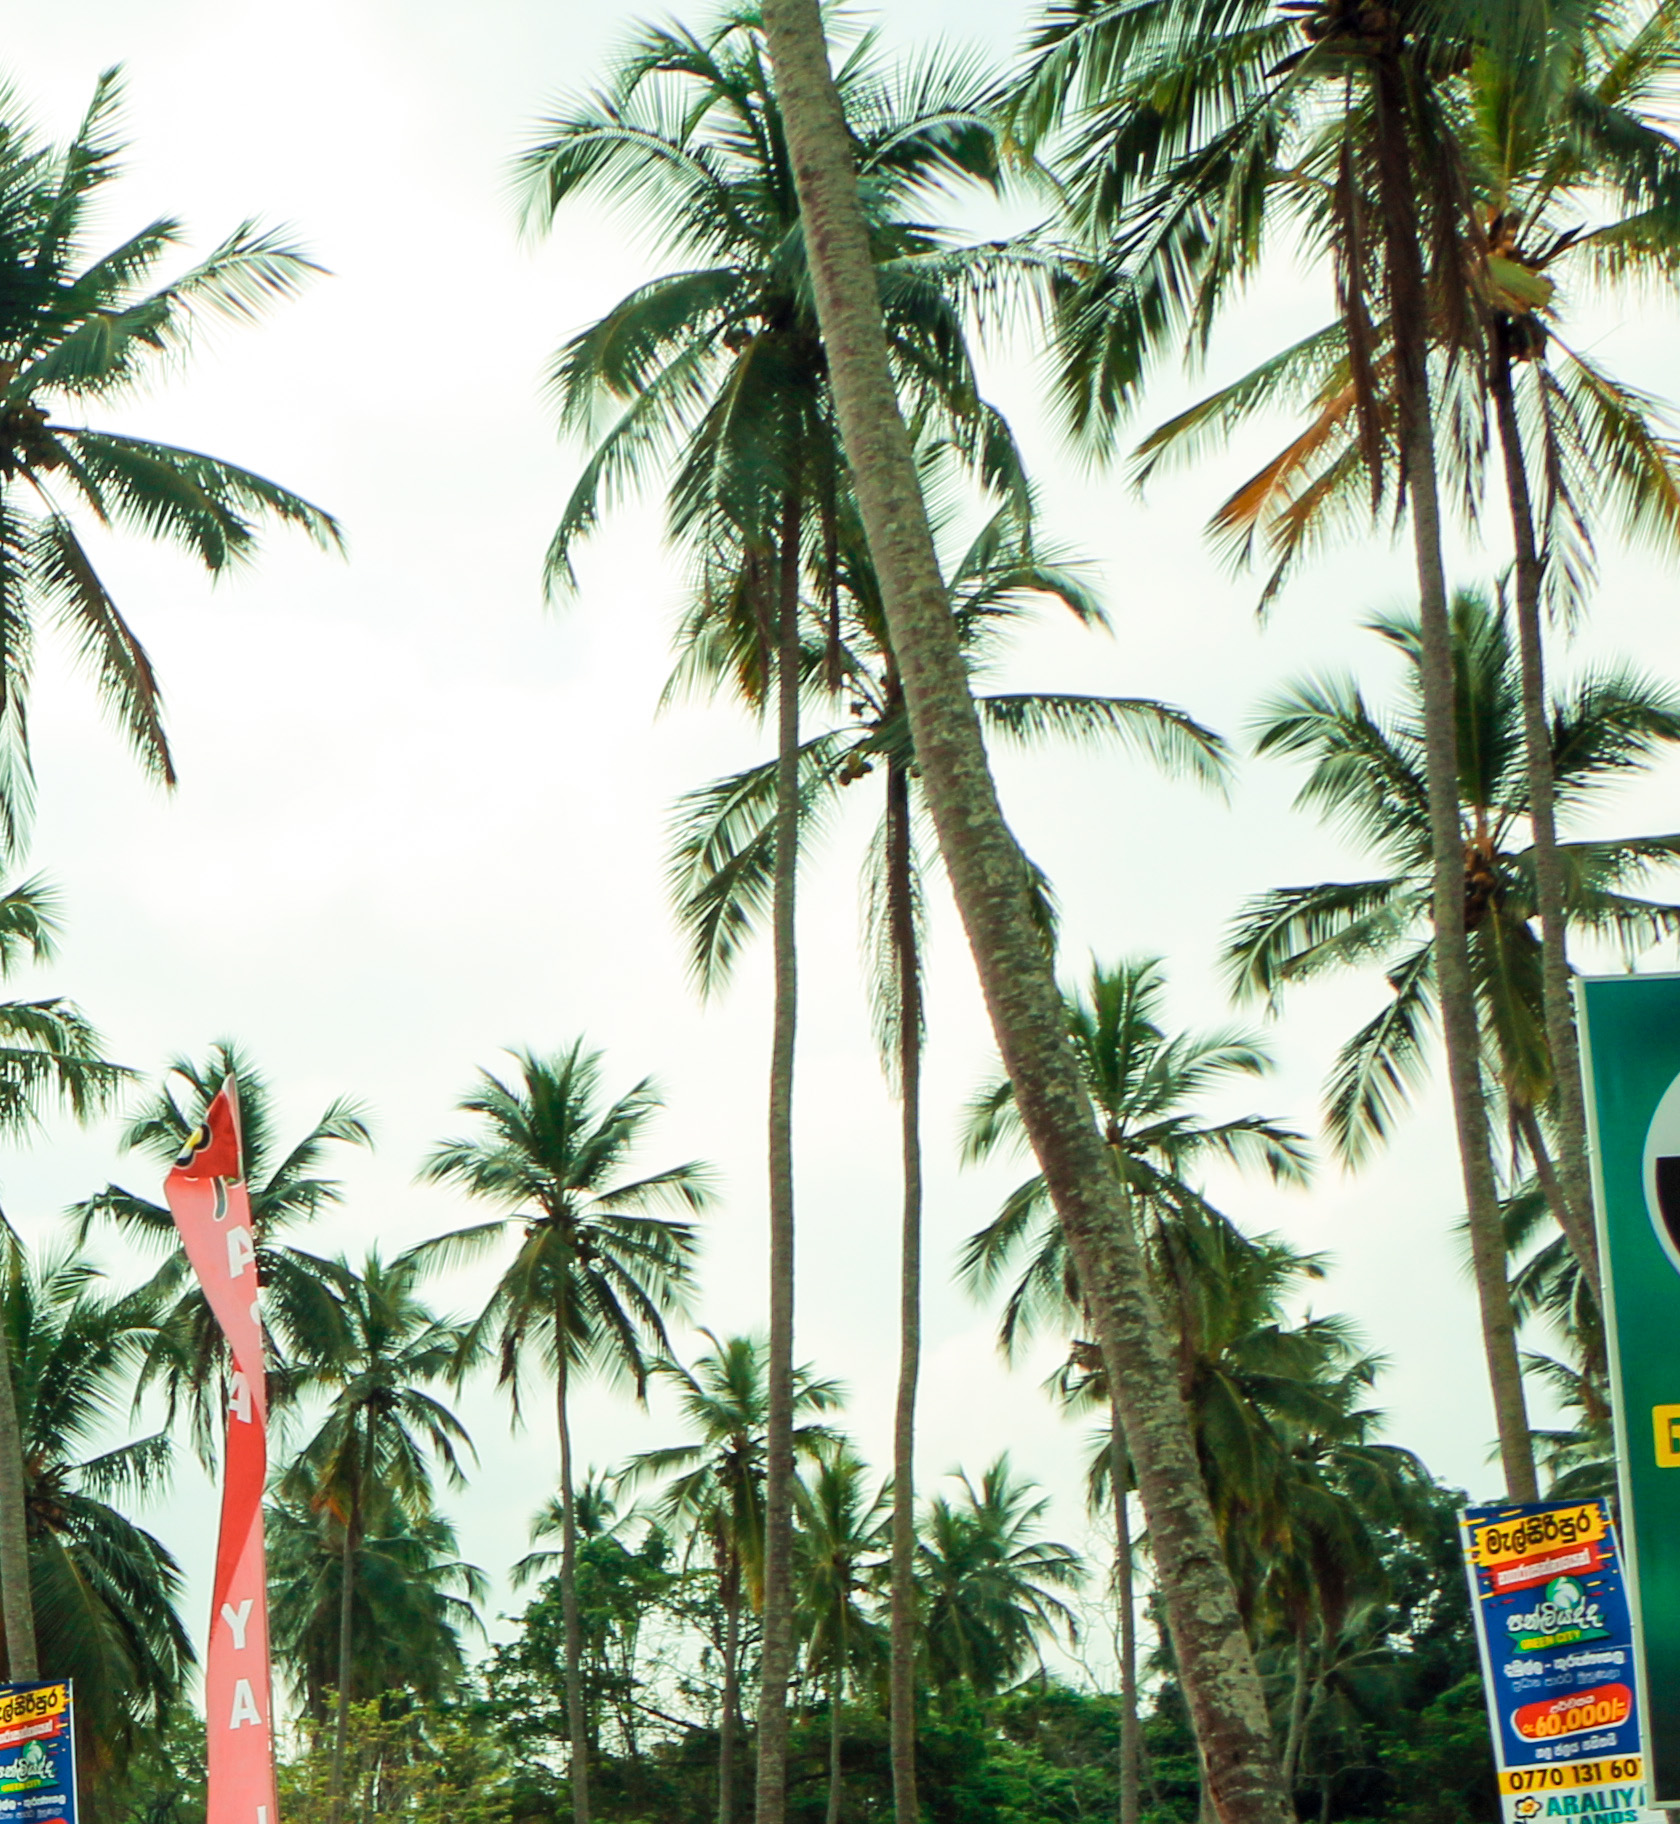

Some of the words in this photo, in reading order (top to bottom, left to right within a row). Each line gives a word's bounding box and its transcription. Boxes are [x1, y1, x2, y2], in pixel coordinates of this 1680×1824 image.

[1510, 1768, 1563, 1790] 0770
[1572, 1763, 1603, 1784] 131
[1611, 1758, 1642, 1779] 60
